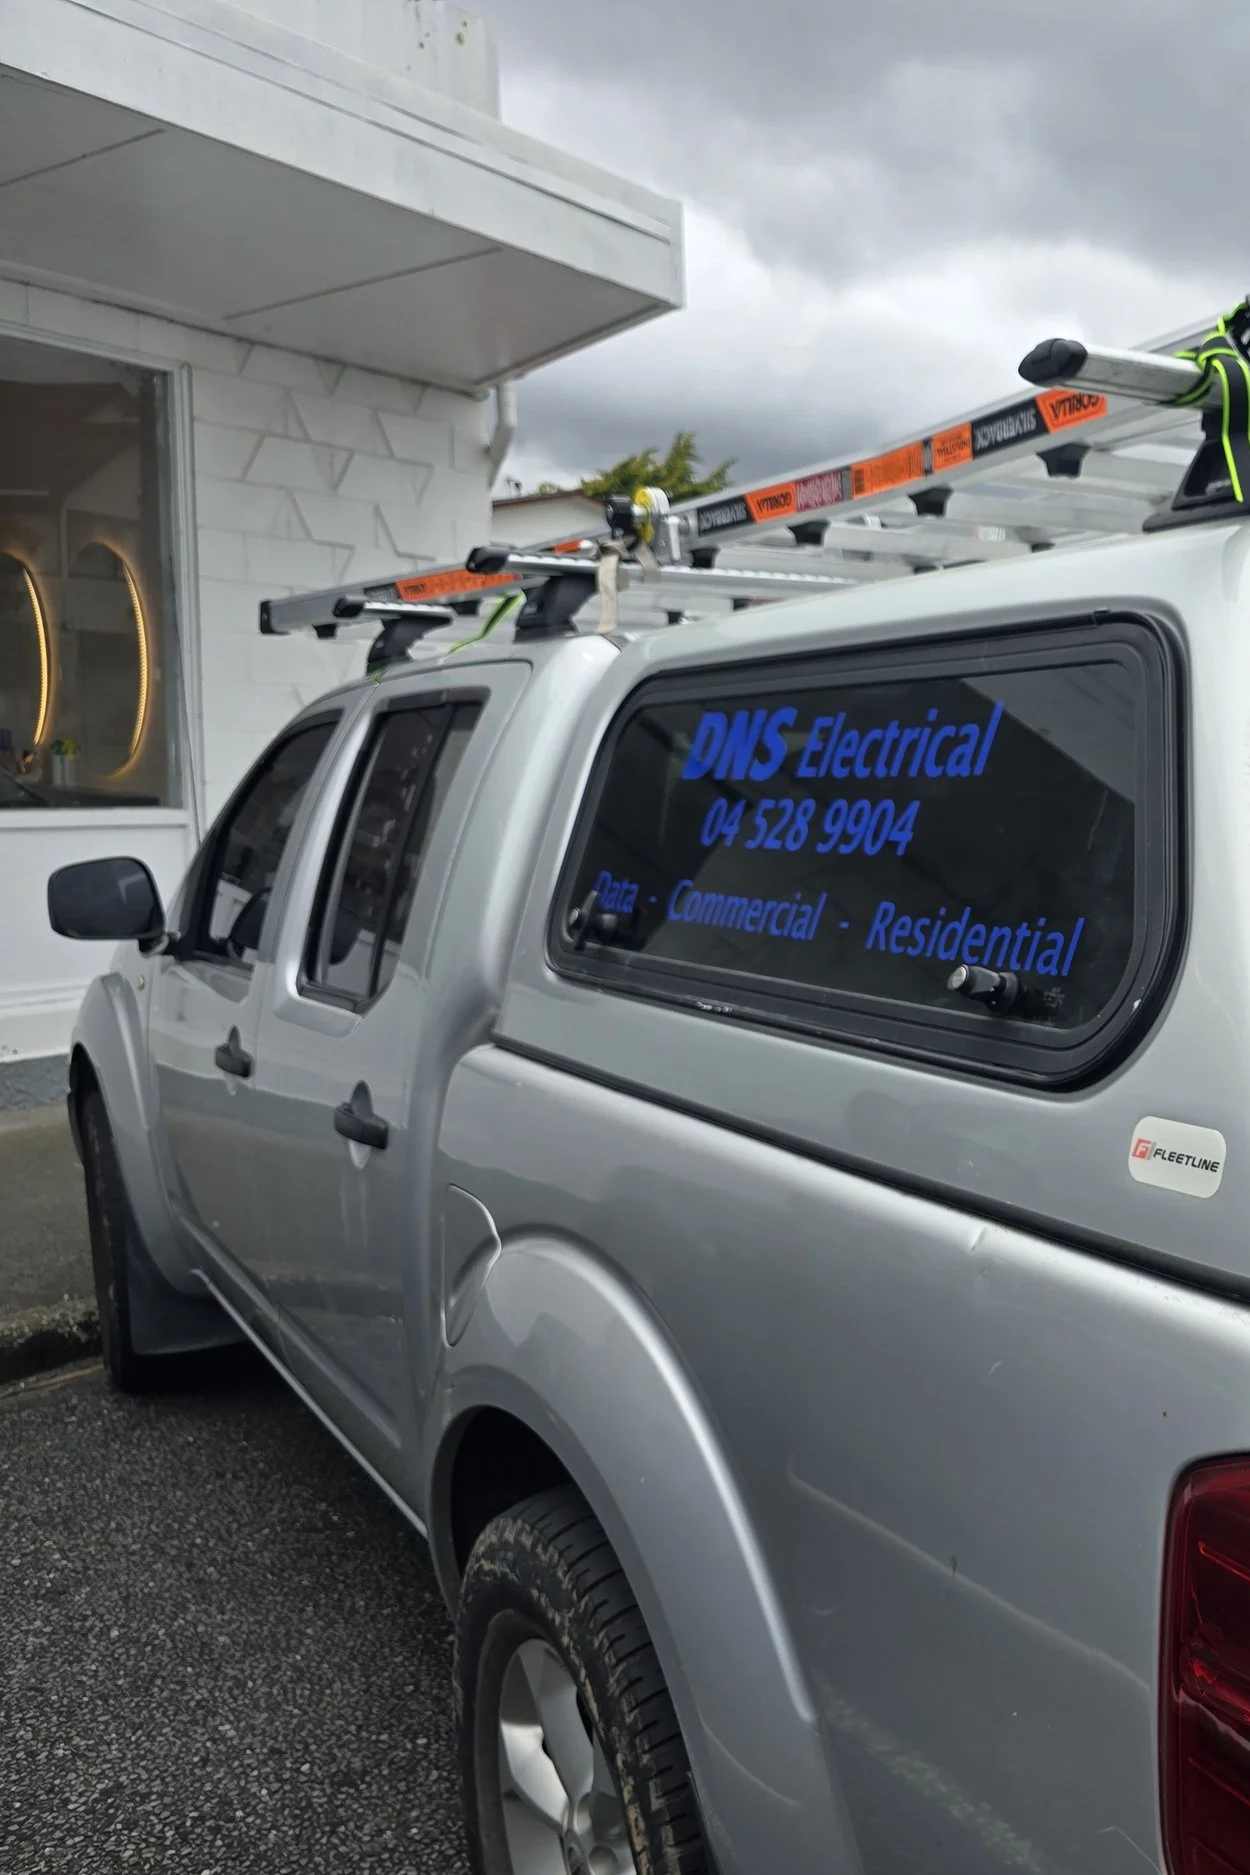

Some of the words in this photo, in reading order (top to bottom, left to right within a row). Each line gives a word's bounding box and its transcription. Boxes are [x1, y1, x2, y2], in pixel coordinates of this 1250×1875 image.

[1050, 393, 1100, 421] GORILLA
[975, 408, 1037, 450] SILVERBACK
[700, 500, 747, 530] SILVERBACK
[754, 491, 793, 514] GORILLA
[680, 705, 798, 783] DNS
[795, 699, 1006, 780] Electrical
[700, 796, 746, 848] 04
[745, 796, 816, 853] 528
[815, 797, 921, 857] 9904
[594, 870, 640, 914] Data
[667, 878, 828, 941] Commercial
[866, 899, 1086, 977] Residential
[1153, 1147, 1220, 1173] FLEETLINE
